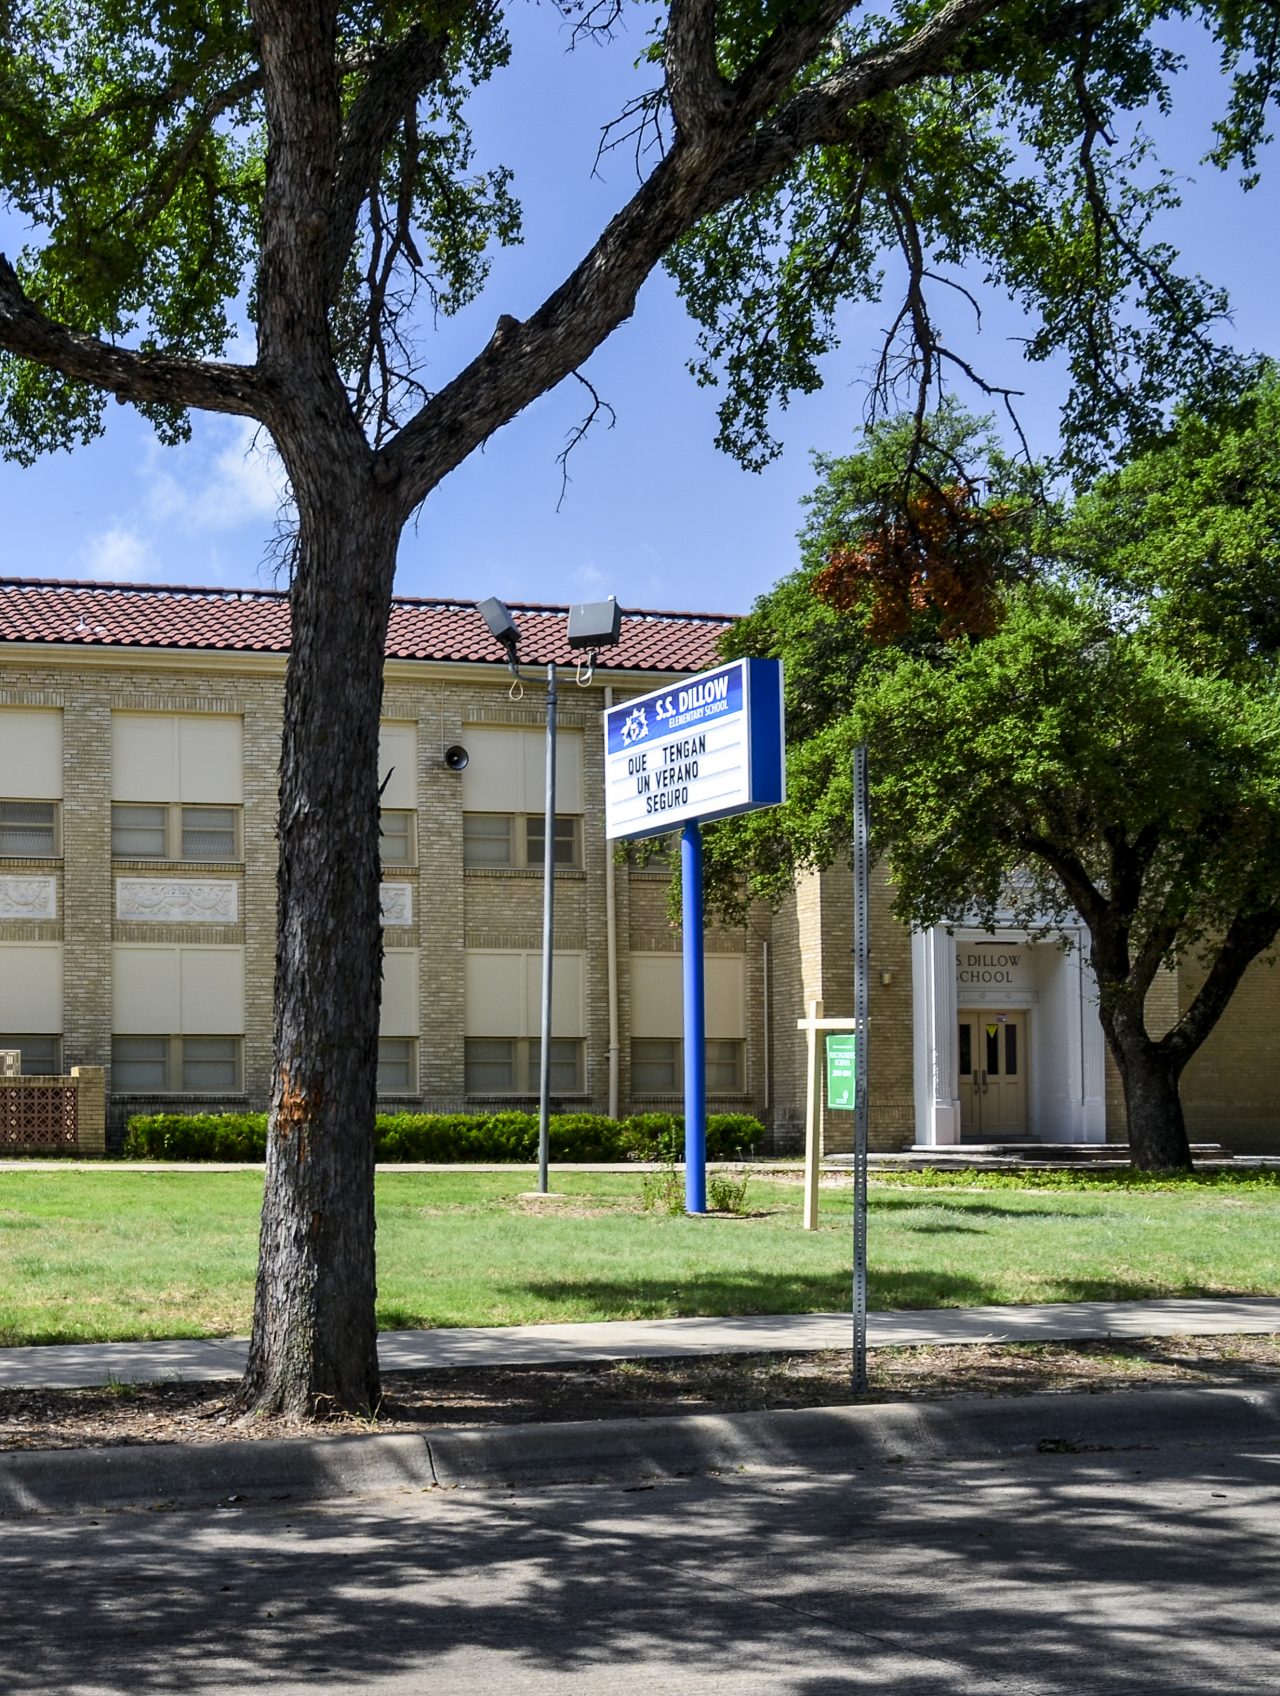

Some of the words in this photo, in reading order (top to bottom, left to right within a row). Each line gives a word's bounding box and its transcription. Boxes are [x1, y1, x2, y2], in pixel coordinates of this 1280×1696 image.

[655, 695, 677, 721] S.S.
[678, 675, 729, 713] DILLOW
[668, 707, 705, 729] ELEMENTARY
[705, 699, 729, 717] SCHOOL
[628, 753, 647, 775] QUE
[662, 735, 707, 765] TENGAN
[637, 774, 650, 794] UN
[655, 760, 699, 790] VERANO
[646, 786, 689, 814] SEGURO
[967, 954, 1021, 967] DILLOW
[956, 970, 1013, 983] CHOOL
